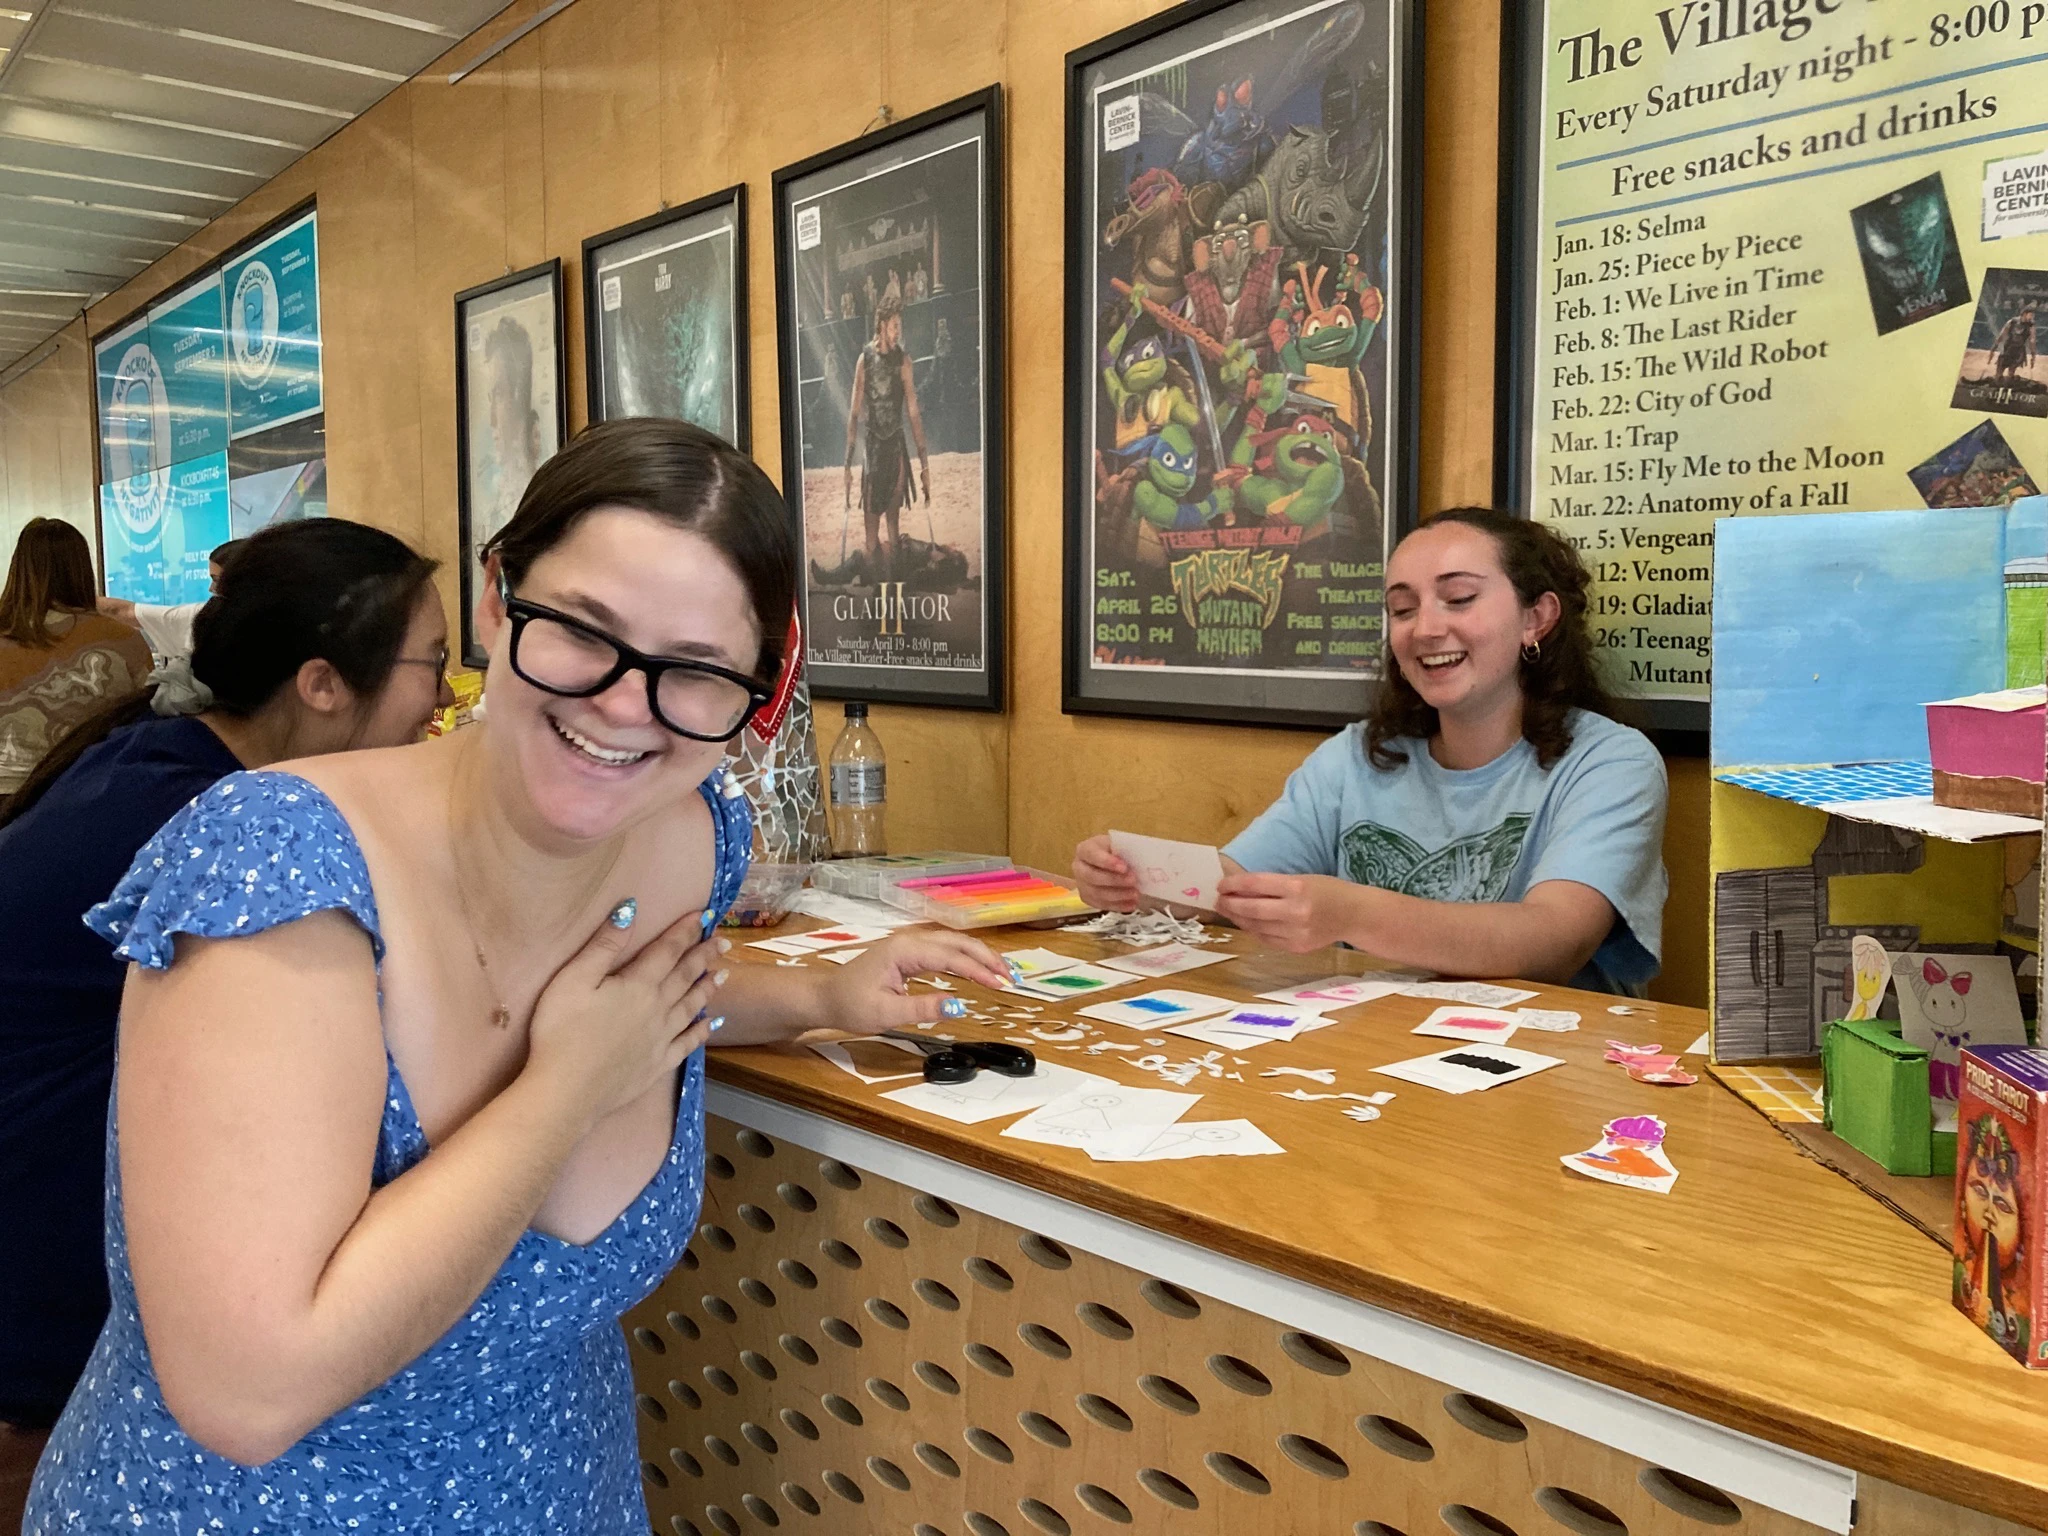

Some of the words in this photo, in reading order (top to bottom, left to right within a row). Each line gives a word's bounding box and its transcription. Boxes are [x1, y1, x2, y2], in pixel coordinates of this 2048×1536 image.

[1555, 103, 1640, 140] Every
[1646, 62, 1790, 117] Saturday
[1798, 34, 1895, 83] night
[1929, 0, 2010, 47] 8:00
[2019, 2, 2048, 40] p
[1557, 27, 1642, 84] The
[1611, 164, 1676, 197] Free
[1683, 133, 1791, 181] snacks
[1802, 112, 1867, 157] and
[1877, 88, 1998, 141] drinks
[1994, 180, 2048, 199] BERNI
[1552, 234, 1594, 262] Jan.
[1600, 224, 1631, 248] 18:
[1637, 214, 1706, 241] Selma
[1552, 267, 1594, 295] Jan.
[1598, 258, 1630, 282] 25:
[1636, 252, 1696, 276] Piece
[1702, 242, 1730, 270] by
[1735, 233, 1803, 259] Piece
[1554, 298, 1597, 322] Feb.
[1602, 295, 1620, 315] 1:
[1625, 286, 1662, 311] We
[1669, 283, 1719, 307] Live
[1724, 277, 1749, 298] in
[1753, 266, 1824, 291] Time
[1553, 331, 1595, 355] Feb.
[1601, 328, 1620, 349] 8:
[1624, 323, 1664, 346] The
[1671, 318, 1722, 340] Last
[1727, 304, 1798, 332] Rider
[1552, 364, 1594, 387] Feb.
[1601, 361, 1631, 383] 15:
[1635, 355, 1677, 378] The
[1683, 344, 1742, 373] Wild
[1750, 338, 1830, 366] Robot
[1551, 398, 1593, 420] Feb.
[1599, 395, 1630, 416] 22:
[1636, 389, 1684, 417] City
[1690, 383, 1716, 408] of
[1719, 378, 1772, 404] God
[1551, 432, 1597, 453] Mar.
[1604, 430, 1621, 449] 1:
[1626, 425, 1679, 450] Trap
[1550, 464, 1597, 485] Mar.
[1604, 462, 1633, 482] 15:
[1640, 457, 1677, 486] Fly
[1682, 454, 1720, 478] Me
[1728, 458, 1750, 475] to
[1758, 450, 1797, 473] the
[1804, 445, 1884, 470] Moon
[1550, 497, 1596, 518] Mar.
[1602, 496, 1632, 516] 22:
[1637, 492, 1743, 517] Anatomy
[1750, 485, 1777, 509] of
[1780, 493, 1792, 507] a
[1799, 482, 1849, 507] Fall
[1567, 536, 1592, 550] pr.
[1596, 530, 1615, 549] 5:
[1620, 527, 1713, 555] Vengean
[1597, 562, 1627, 582] 12:
[1632, 561, 1710, 582] Venom
[834, 594, 951, 621] GLADIATOR
[1150, 595, 1177, 615] 26
[1199, 597, 1263, 627] MUTANT
[1597, 595, 1626, 615] 19:
[837, 636, 870, 653] Saturday
[872, 637, 893, 654] April
[895, 637, 905, 650] 19
[912, 637, 931, 651] 8:00
[933, 641, 948, 655] pm
[1096, 623, 1140, 643] 8:00
[1196, 628, 1263, 657] MAYHEM
[1596, 628, 1626, 648] 26:
[1630, 627, 1711, 657] Teenag
[809, 648, 824, 661] The
[825, 649, 851, 664] Village
[906, 652, 933, 666] snacks
[935, 653, 952, 667] and
[953, 653, 982, 668] drinks
[1966, 1060, 1994, 1093] PRIDE
[1997, 1078, 2029, 1113] TAROT
